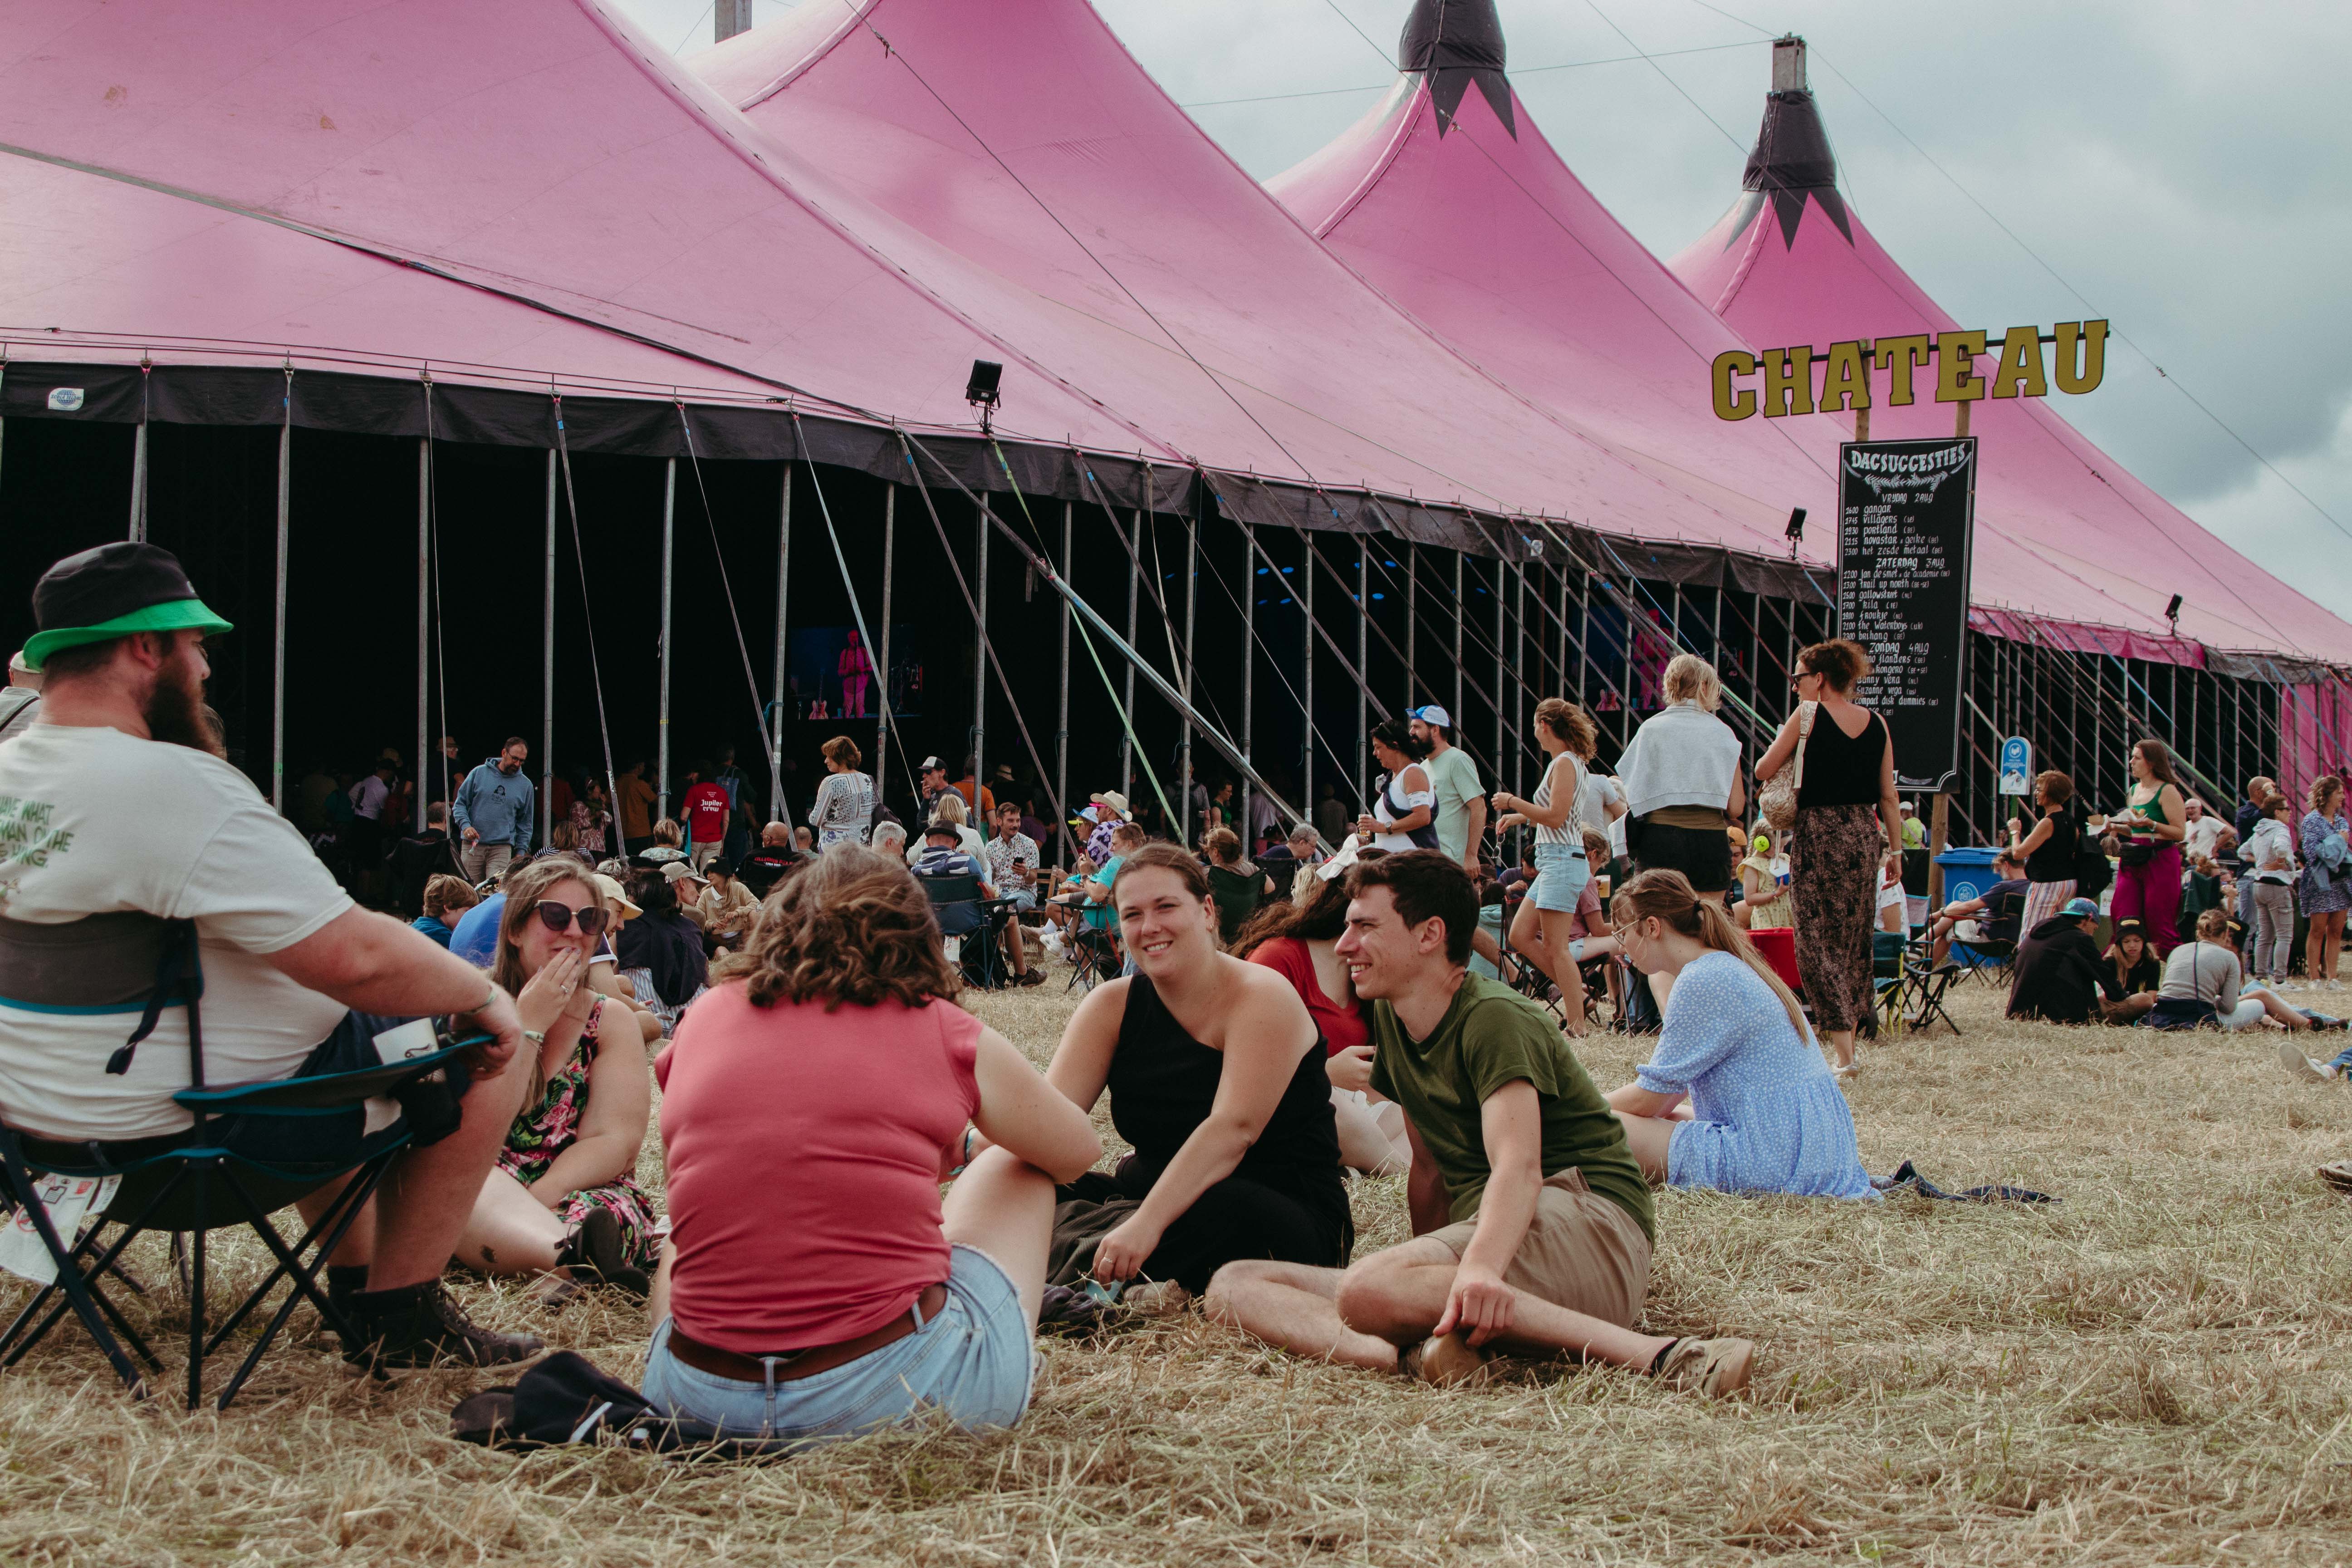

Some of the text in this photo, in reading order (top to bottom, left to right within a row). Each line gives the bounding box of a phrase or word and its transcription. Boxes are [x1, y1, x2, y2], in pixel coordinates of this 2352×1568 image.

[1711, 319, 2109, 421] CHATEAU
[1851, 443, 1965, 472] DAGSUGGESTIES
[1863, 516, 1897, 525] villagers
[1863, 524, 1897, 536] portland
[1864, 534, 1897, 544] novastar
[1877, 546, 1899, 554] zesde
[1904, 545, 1929, 554] metaal
[1876, 558, 1917, 570] ZATERDAG
[1874, 568, 1882, 578] de
[1883, 568, 1898, 578] smet
[1904, 569, 1911, 578] de
[1880, 581, 1887, 589] up
[1890, 579, 1909, 588] north
[1859, 590, 1898, 601] gallowstreet
[1863, 600, 1878, 608] kila
[1859, 620, 1869, 629] the
[1859, 630, 1887, 642] brihang
[1878, 655, 1911, 665] flanders
[1876, 666, 1903, 676] kongero
[1888, 687, 1902, 696] vega
[1882, 696, 1894, 704] disk
[1899, 696, 1926, 705] dummies
